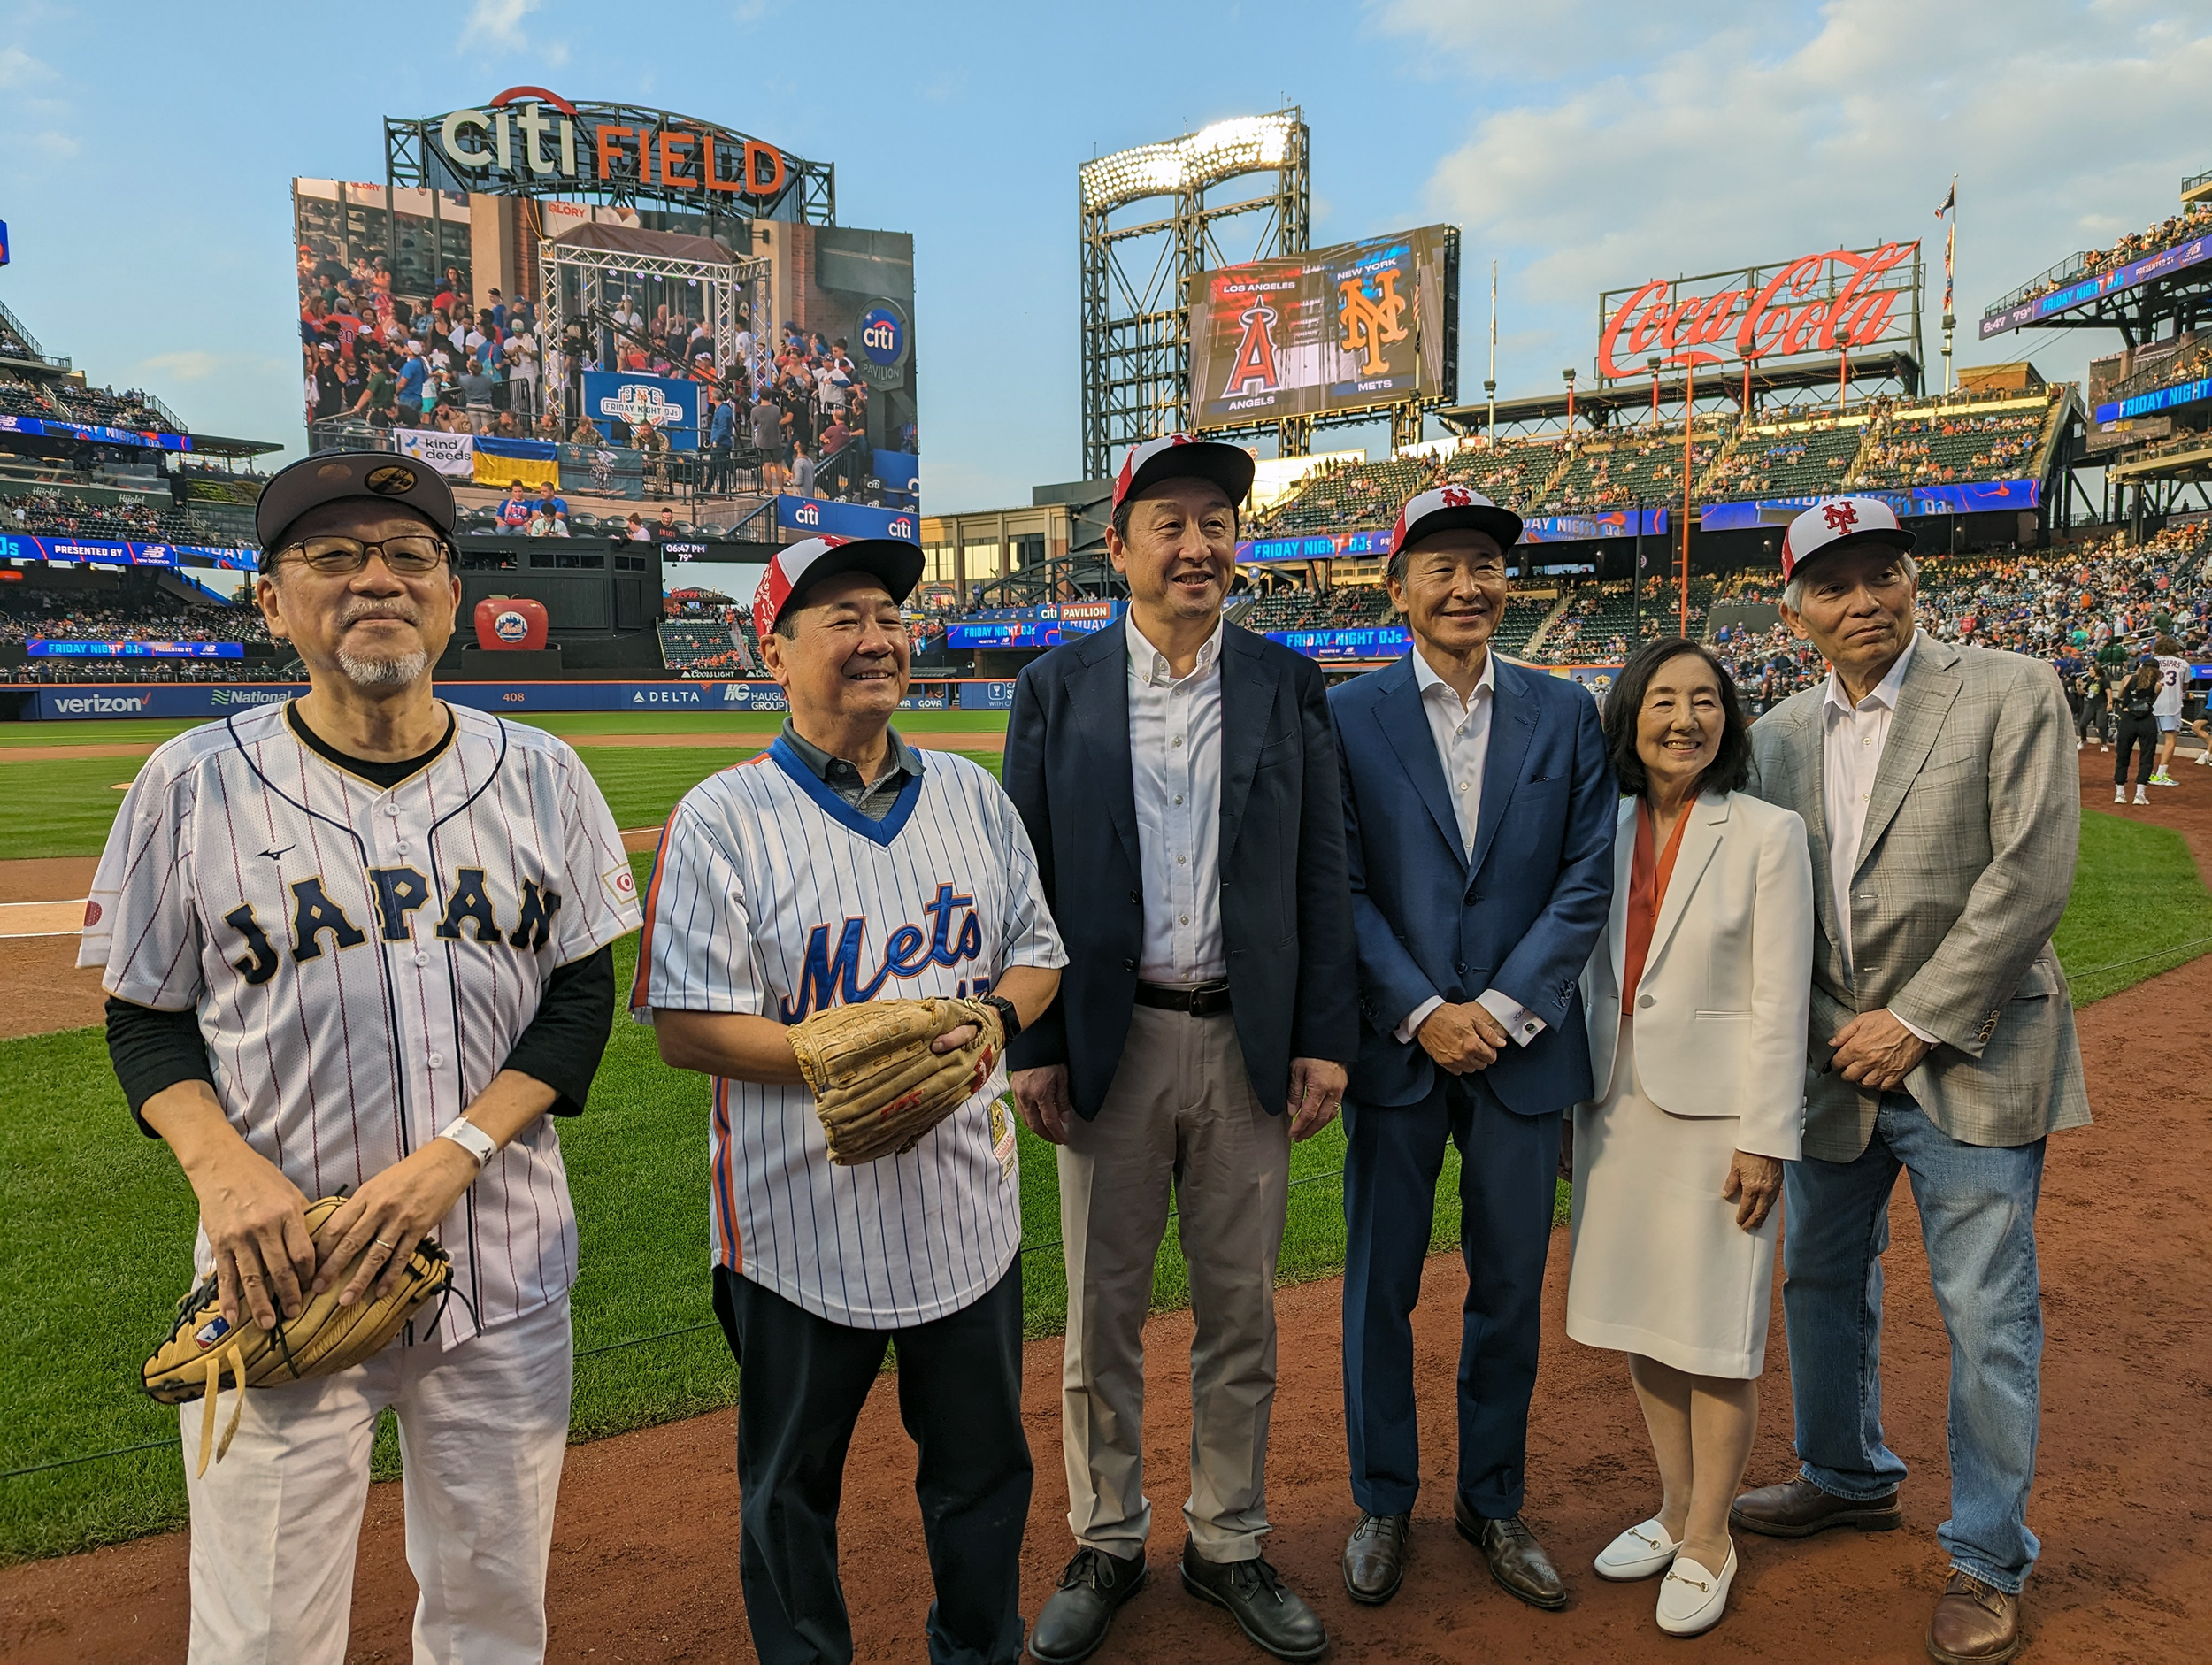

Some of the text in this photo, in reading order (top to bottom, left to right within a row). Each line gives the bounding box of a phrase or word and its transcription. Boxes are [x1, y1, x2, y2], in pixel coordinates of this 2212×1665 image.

[442, 101, 786, 195] citi FIELD
[549, 203, 585, 218] GLORY
[1337, 258, 1396, 280] NEW YORK
[2135, 259, 2166, 276] PRESENTED
[1223, 281, 1295, 293] LOS ANGELES
[2042, 272, 2124, 312] FRIDAY NIGHT DJs
[1599, 236, 1923, 378] Coca-Cola
[1983, 316, 2007, 333] 6:47
[864, 326, 894, 350] citi
[864, 364, 900, 380] PAVILION
[1357, 380, 1393, 392] METS
[1228, 395, 1275, 410] ANGELS
[2119, 379, 2210, 418] FRIDAY NIGHT
[605, 403, 634, 413] FRIDAY
[638, 405, 662, 415] NGHT
[664, 408, 679, 417] DJs
[426, 438, 457, 449] kind
[426, 449, 474, 461] deeds.
[867, 479, 880, 489] citi
[795, 506, 819, 526] citi
[888, 520, 911, 539] citi
[55, 545, 123, 557] PRESENTED BY
[666, 544, 690, 553] 06:47
[1254, 541, 1300, 559] FRIDAY
[1303, 538, 1344, 556] NIGHT
[1348, 536, 1371, 552] DJs
[1041, 606, 1107, 619] citi PAVILION
[964, 625, 1036, 638] FRIDAY NIGHT DJs
[1286, 630, 1402, 648] FRIDAY NIGHT DJs
[48, 644, 143, 654] FRIDAY NIGHT DJs
[691, 669, 714, 678] Coors
[55, 694, 142, 713] verizon
[230, 691, 291, 704] National
[503, 693, 525, 702] 408
[649, 691, 700, 702] DELTA
[751, 702, 785, 710] GROUP
[222, 866, 562, 985] JAPAN
[780, 882, 982, 1025] Mets
